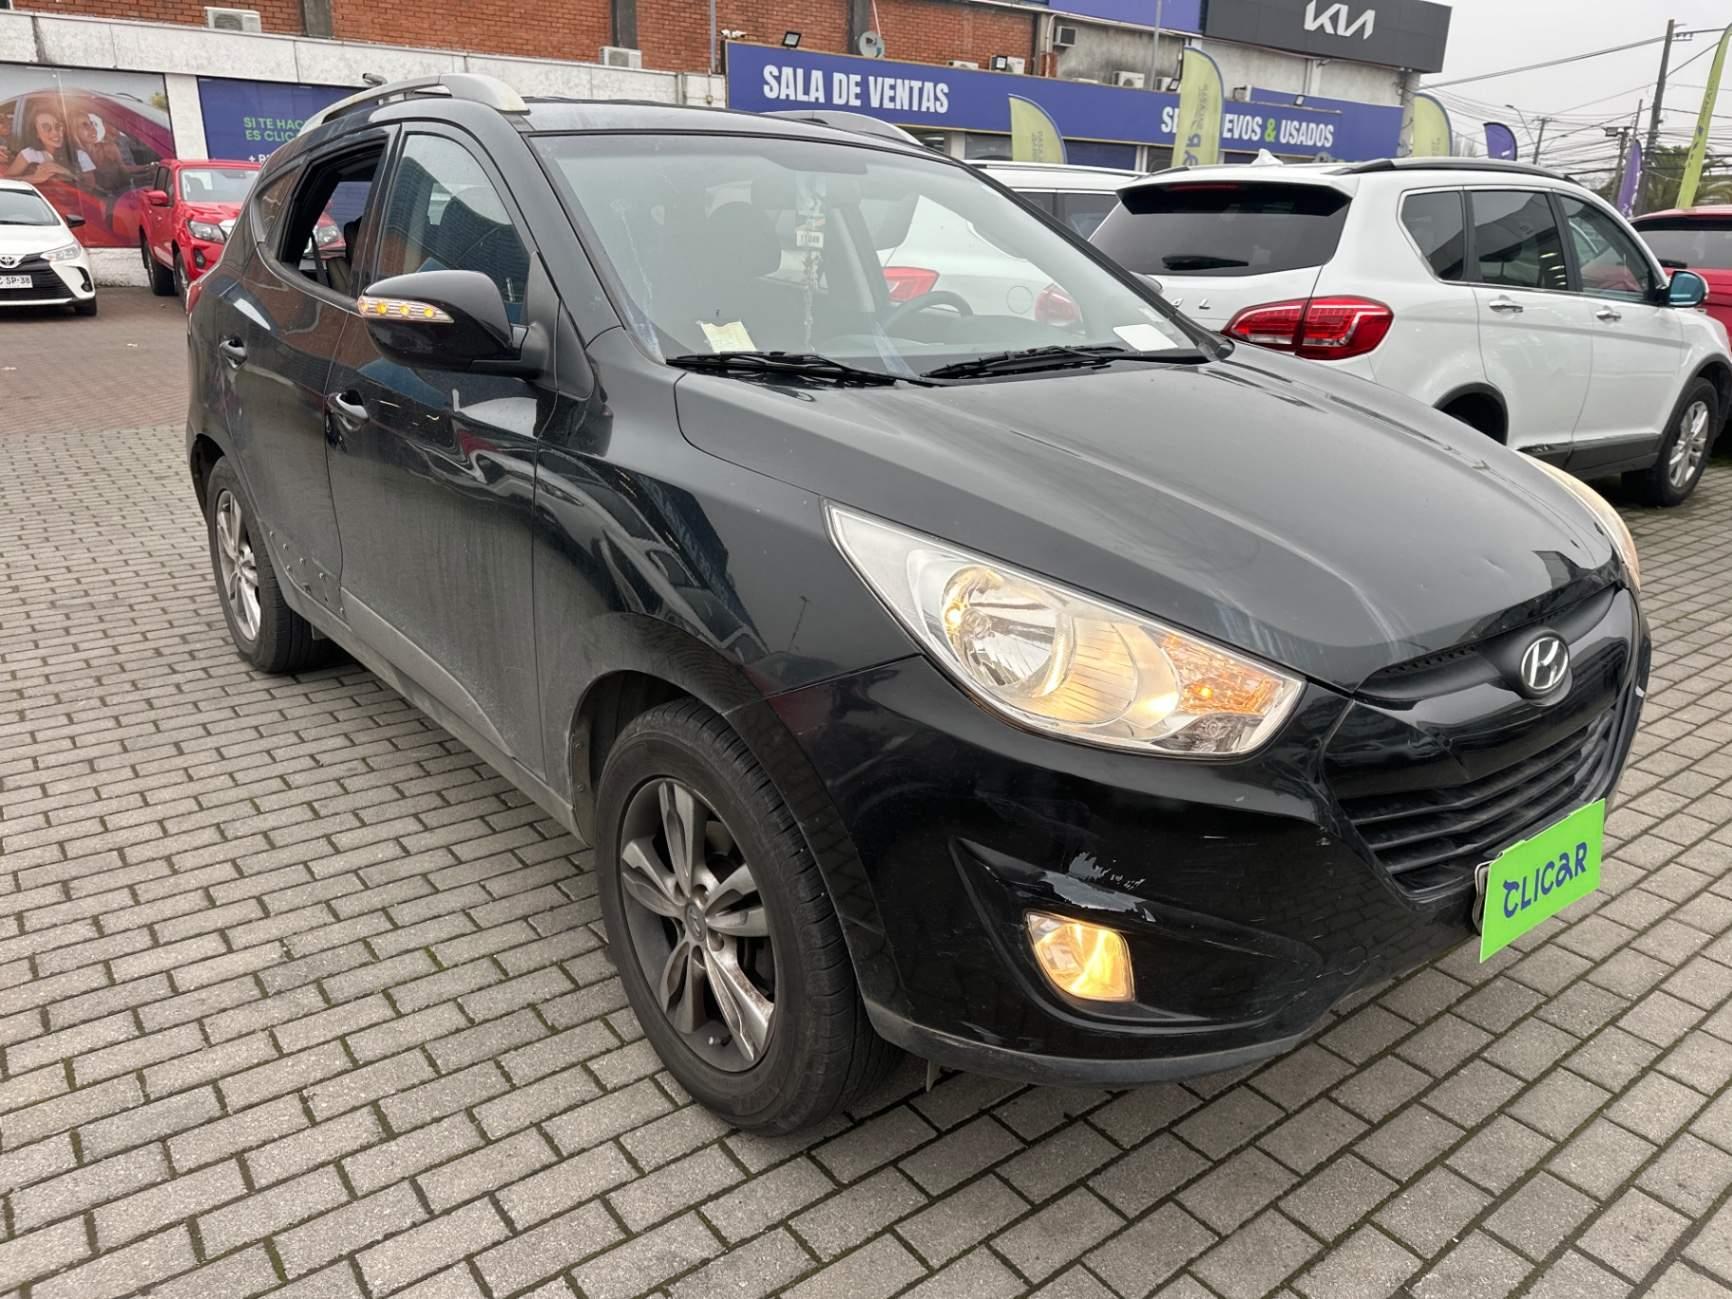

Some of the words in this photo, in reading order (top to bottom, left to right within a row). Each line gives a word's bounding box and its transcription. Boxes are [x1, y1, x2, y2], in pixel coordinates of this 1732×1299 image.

[1303, 0, 1376, 40] KIA
[763, 64, 826, 104] SALA
[832, 72, 862, 107] DE
[868, 76, 950, 114] VENTAS
[243, 117, 257, 128] SI
[257, 118, 273, 129] TE
[276, 119, 304, 130] HAC
[245, 130, 261, 141] ES
[263, 130, 295, 142] CLIC
[1264, 118, 1277, 143] &
[1279, 119, 1334, 147] USADOS
